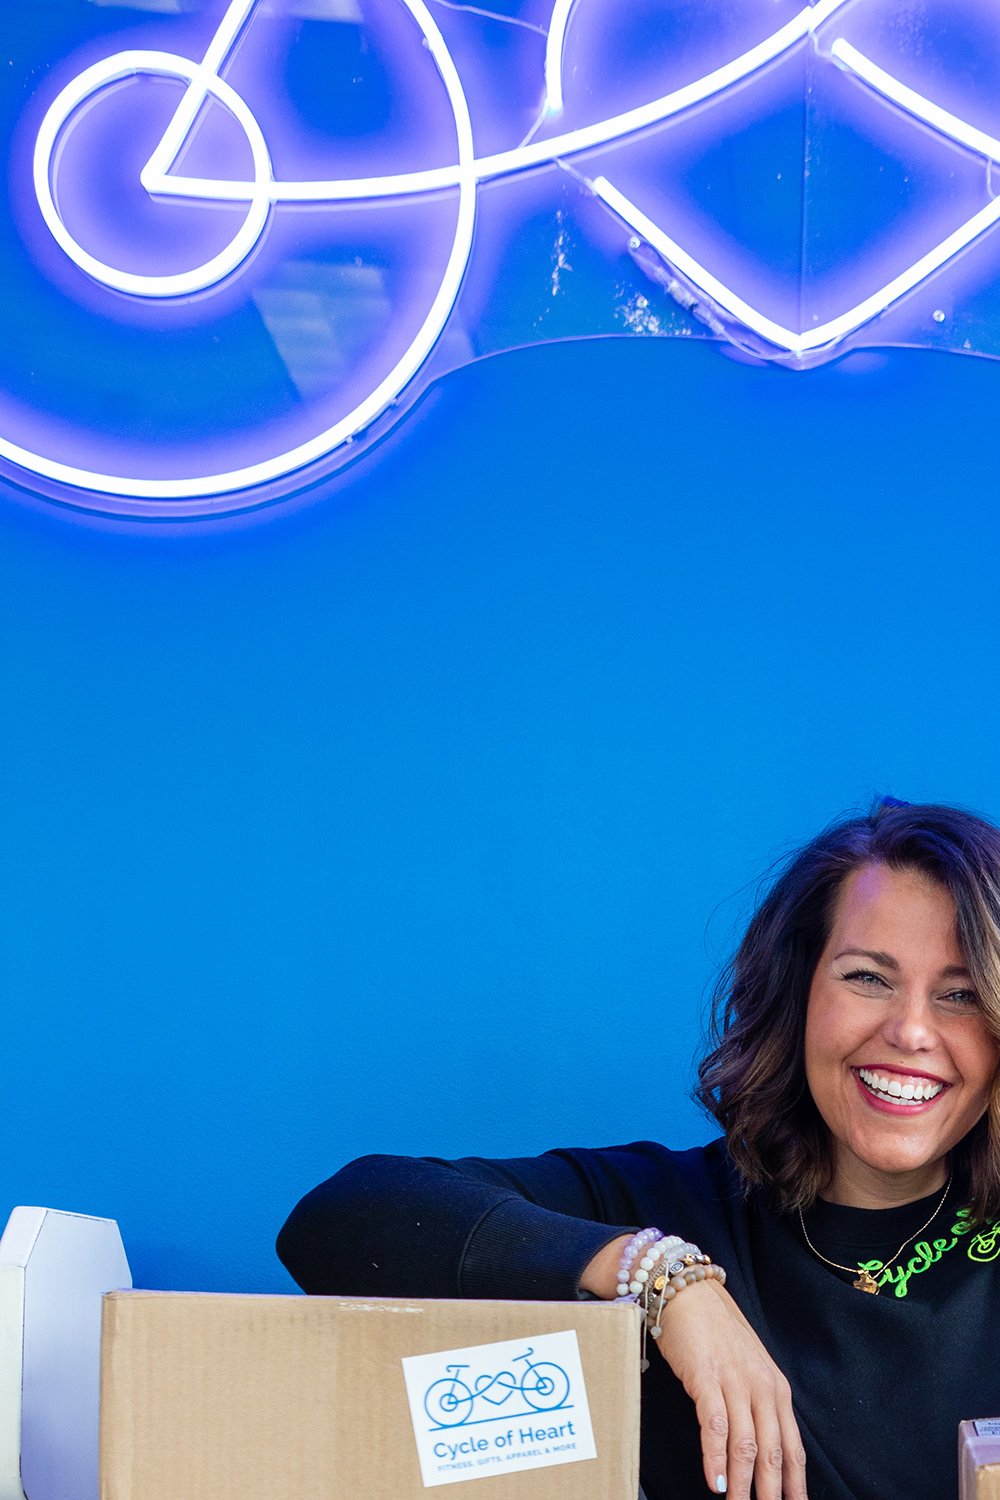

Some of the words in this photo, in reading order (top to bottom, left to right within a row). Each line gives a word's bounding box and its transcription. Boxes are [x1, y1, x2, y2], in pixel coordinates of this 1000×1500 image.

[433, 1437, 489, 1461] Cycle
[495, 1430, 513, 1448] of
[519, 1421, 576, 1444] Heart
[553, 1442, 577, 1452] MORE
